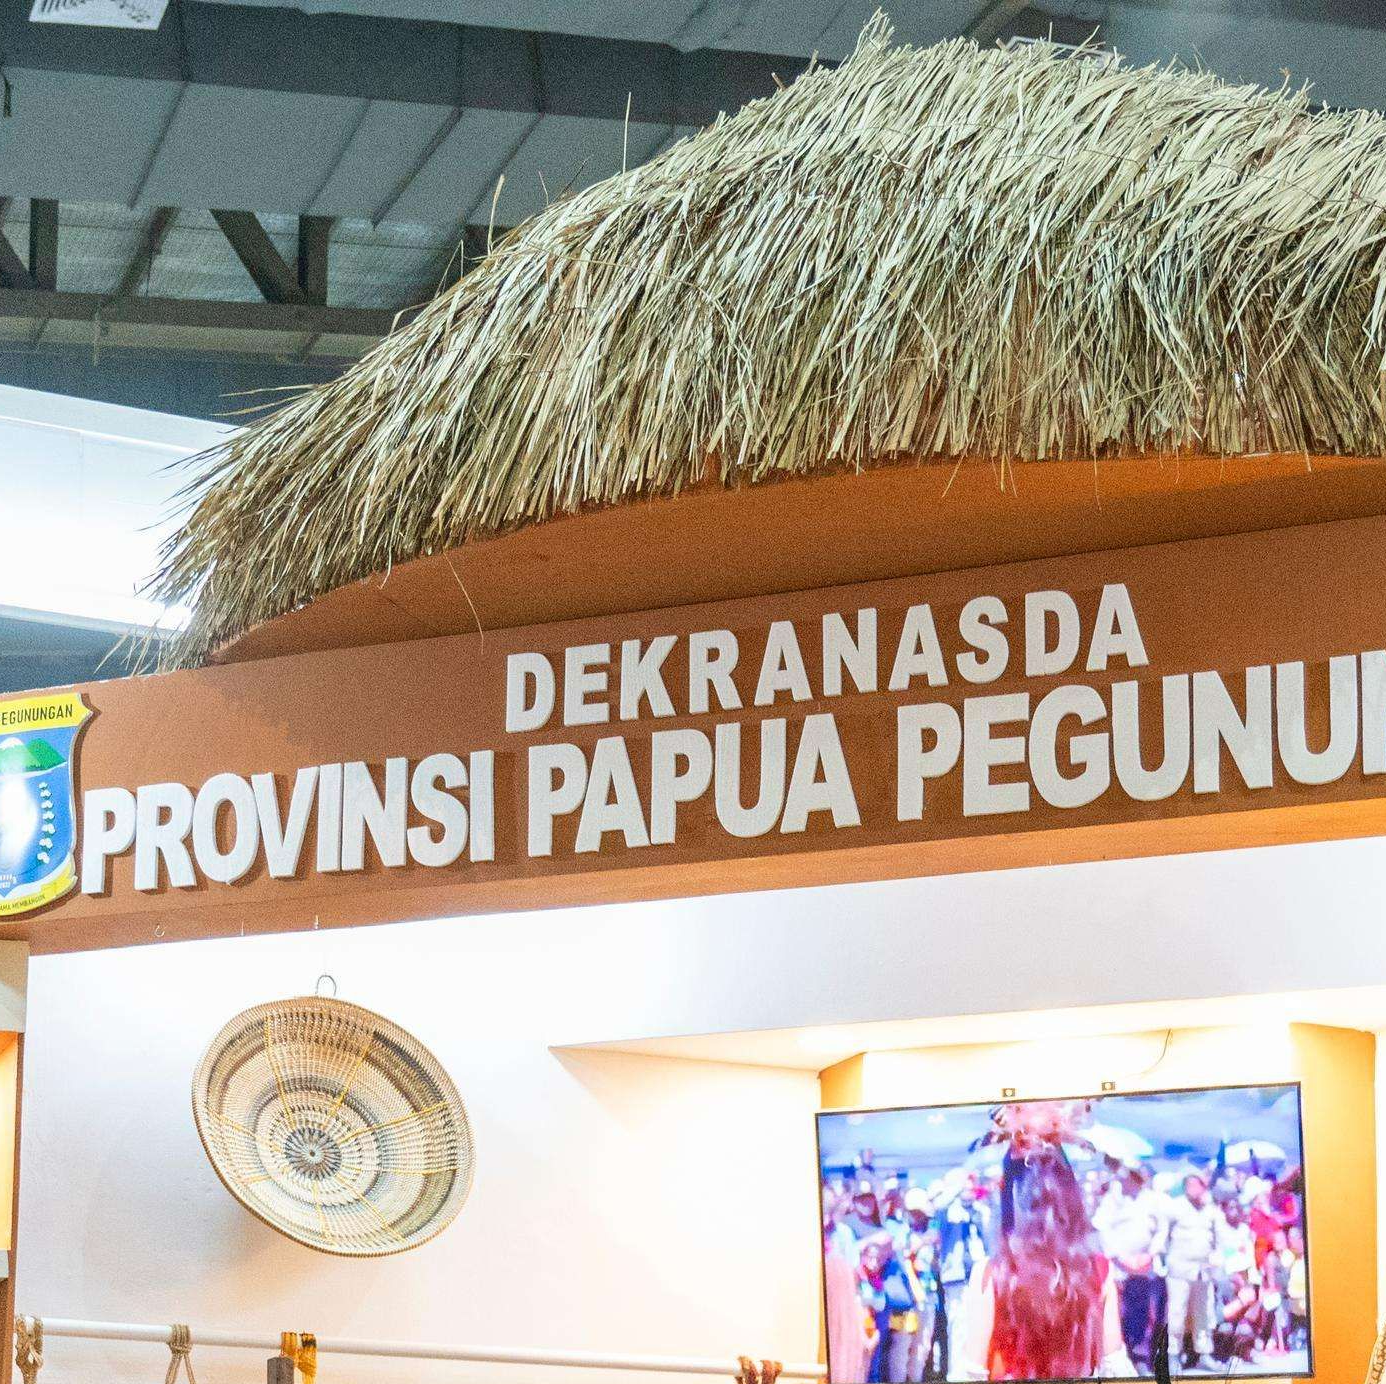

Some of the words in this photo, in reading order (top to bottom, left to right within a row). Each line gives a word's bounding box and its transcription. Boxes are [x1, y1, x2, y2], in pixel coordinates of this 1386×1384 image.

[505, 582, 1150, 733] DEKRANASDA
[81, 749, 496, 895] PROVINSI
[527, 713, 862, 858] PAPUA
